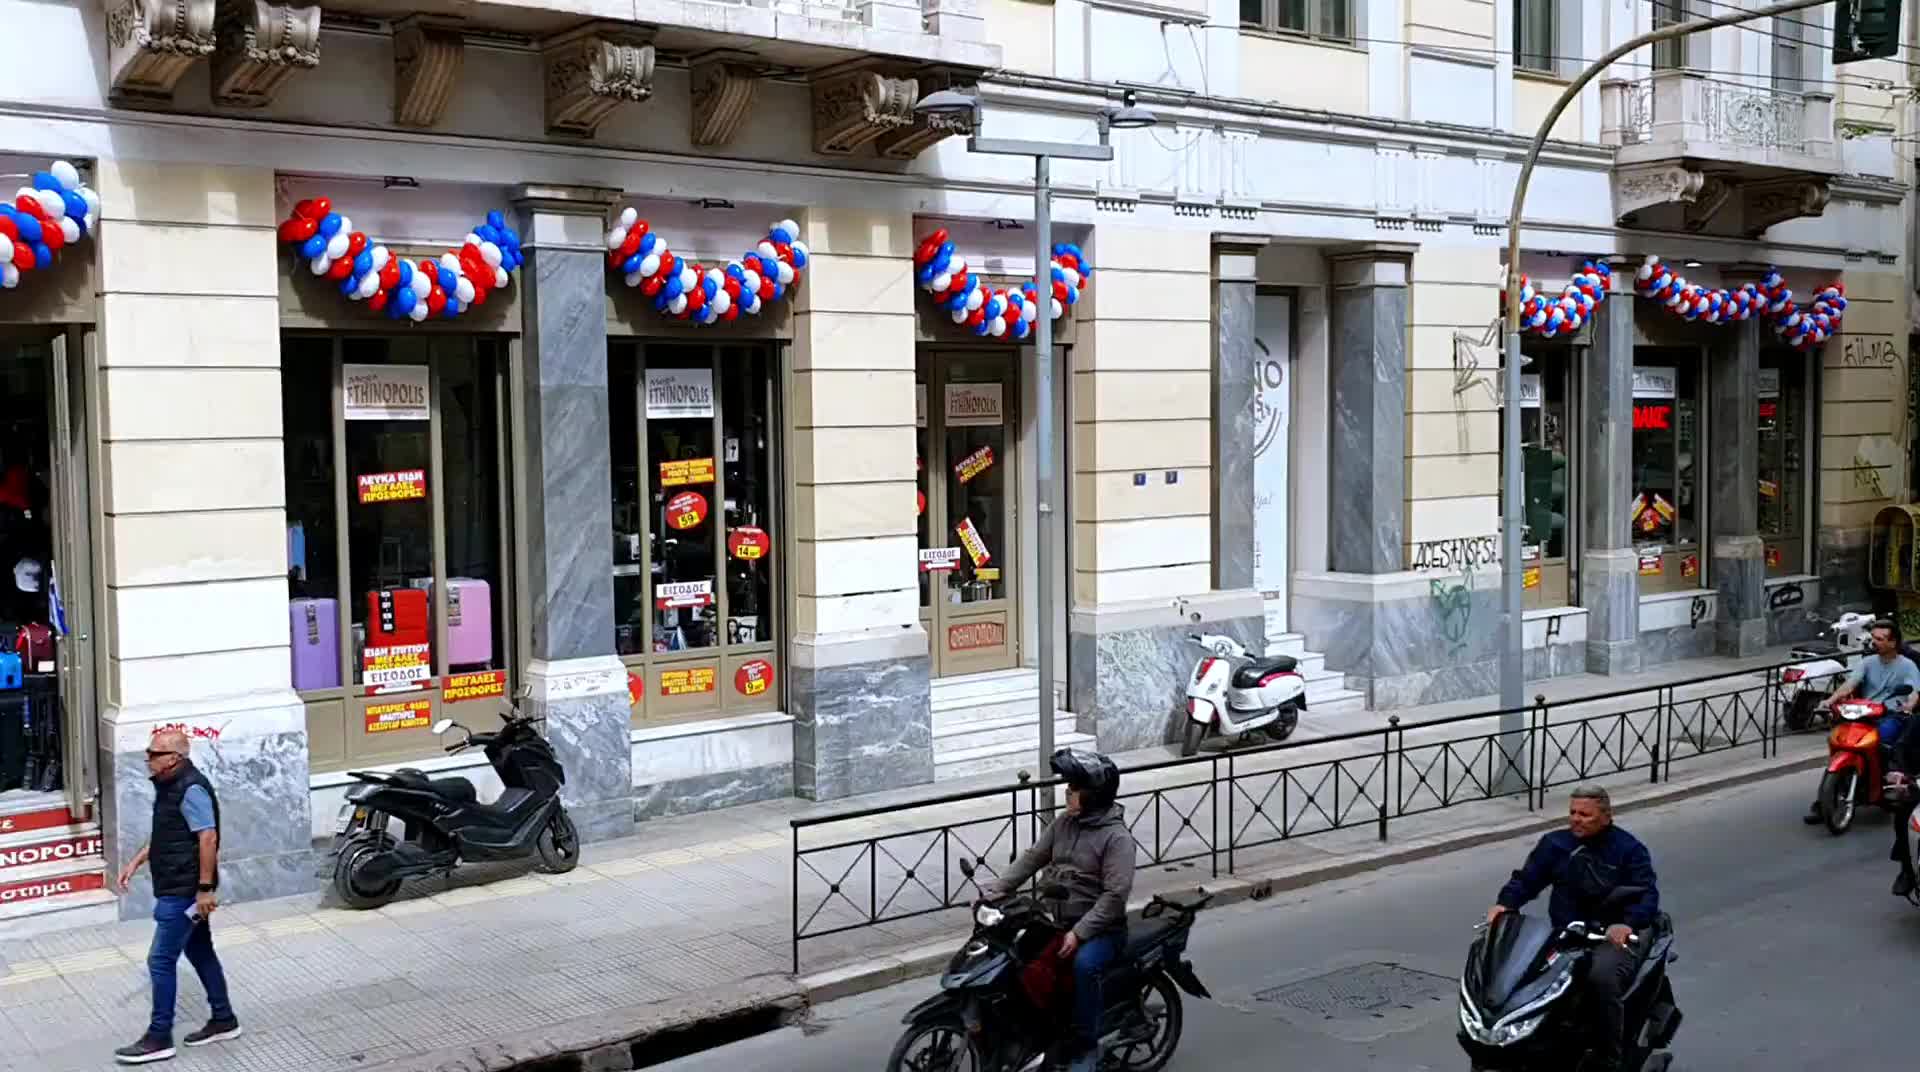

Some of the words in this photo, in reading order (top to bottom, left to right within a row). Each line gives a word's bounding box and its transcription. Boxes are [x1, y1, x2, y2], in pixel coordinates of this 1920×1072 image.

[346, 383, 425, 404] FTHINOPOLIS
[648, 384, 709, 404] FTHINOPOLIS
[360, 474, 397, 487] ΛΕΥΚΑ
[398, 471, 424, 481] ΕΙΔΗ
[662, 583, 705, 595] ΕΙΣΟΔΟΣ
[371, 668, 423, 683] ΕΙΣΟΔΟΣ
[450, 672, 496, 688] ΜΕΓΑΛΕΣ
[444, 682, 504, 699] ΠΡΟΣΦΟΡΕΣ
